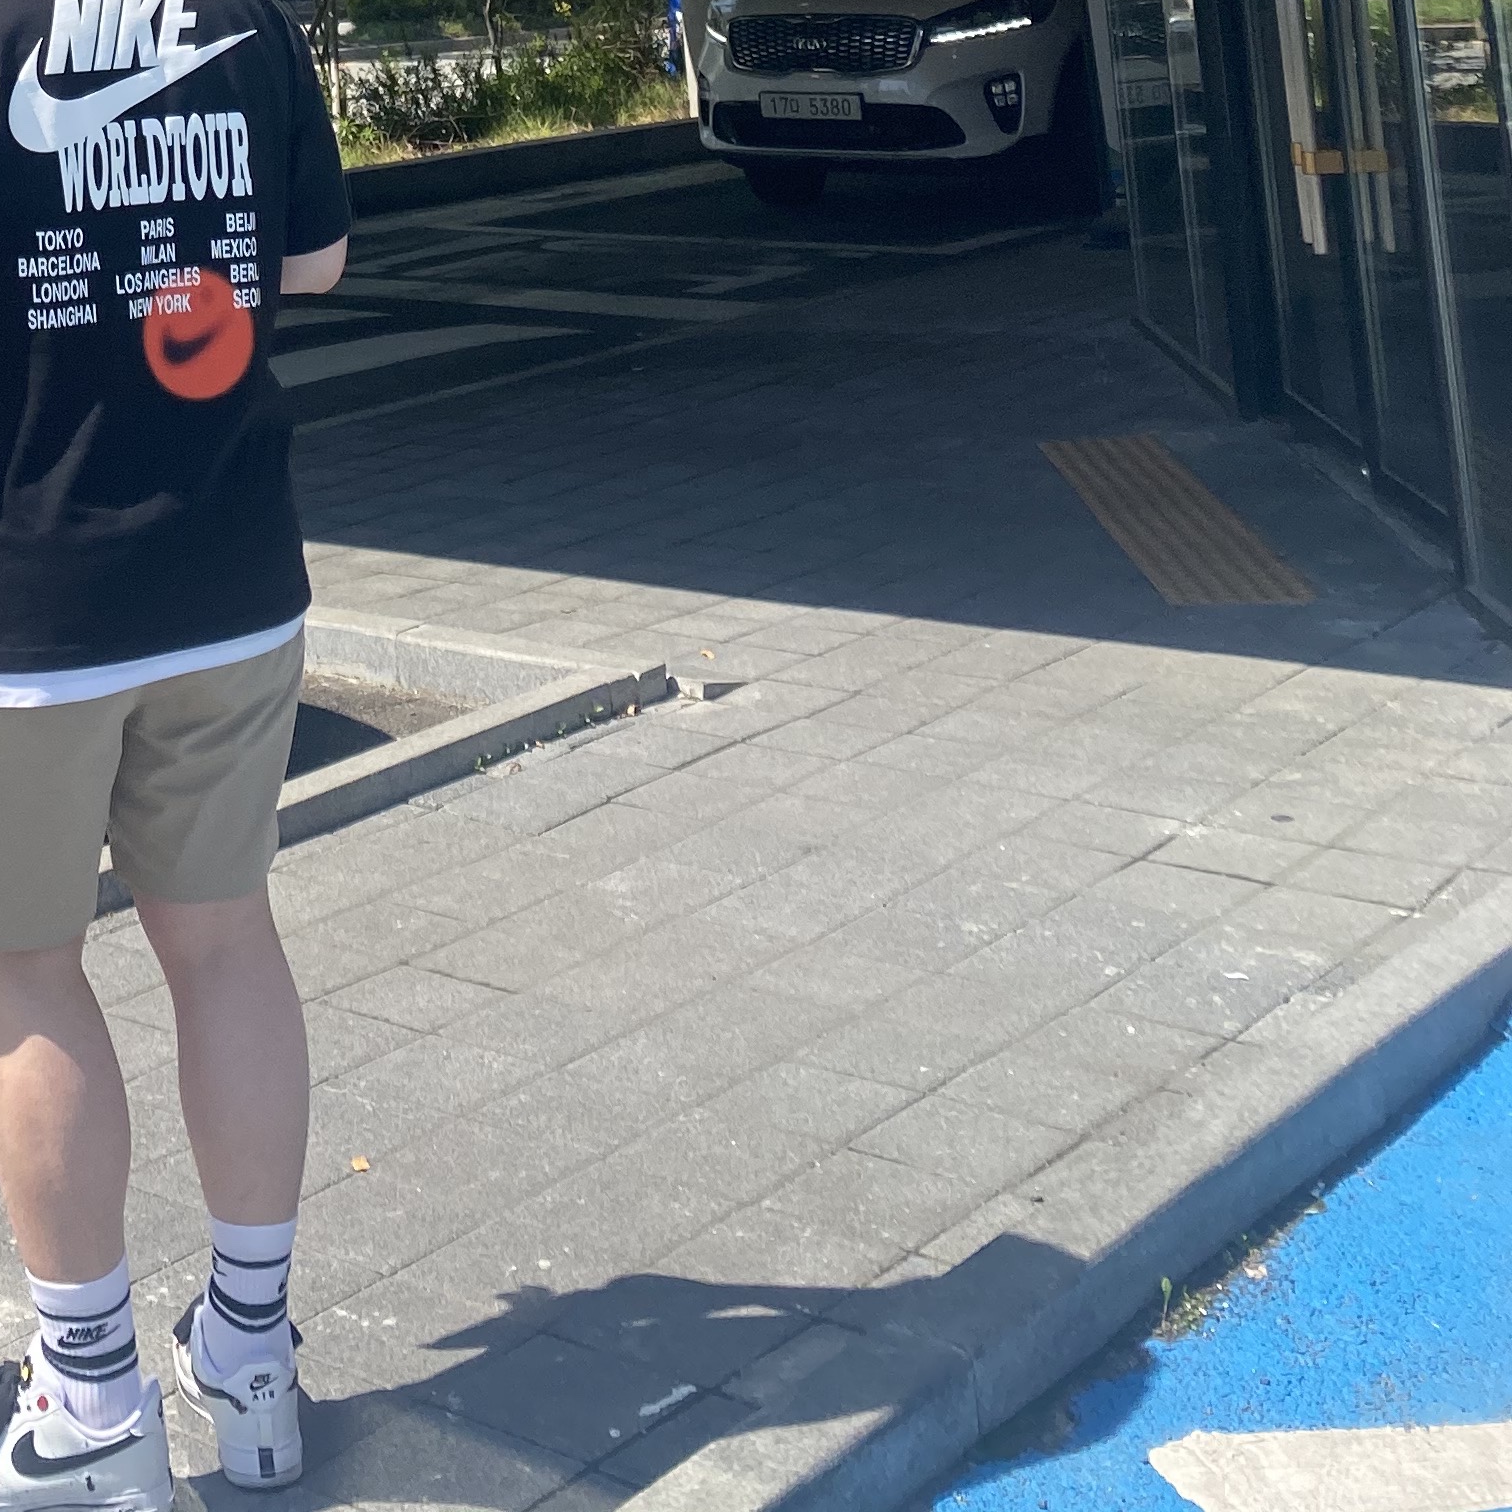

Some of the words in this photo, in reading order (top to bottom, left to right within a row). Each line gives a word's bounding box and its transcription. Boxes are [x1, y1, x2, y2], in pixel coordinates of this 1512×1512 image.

[36, 228, 84, 251] TOKYO
[140, 217, 175, 240] PARIS
[141, 242, 176, 266] MILAN
[210, 236, 257, 260] MEXICO
[18, 251, 101, 278] BARCELONA
[32, 278, 89, 303] LONDON
[28, 303, 98, 330] SHANGHAI
[129, 296, 153, 320] NEW
[155, 293, 192, 316] YORK
[66, 1322, 109, 1342] NIKE
